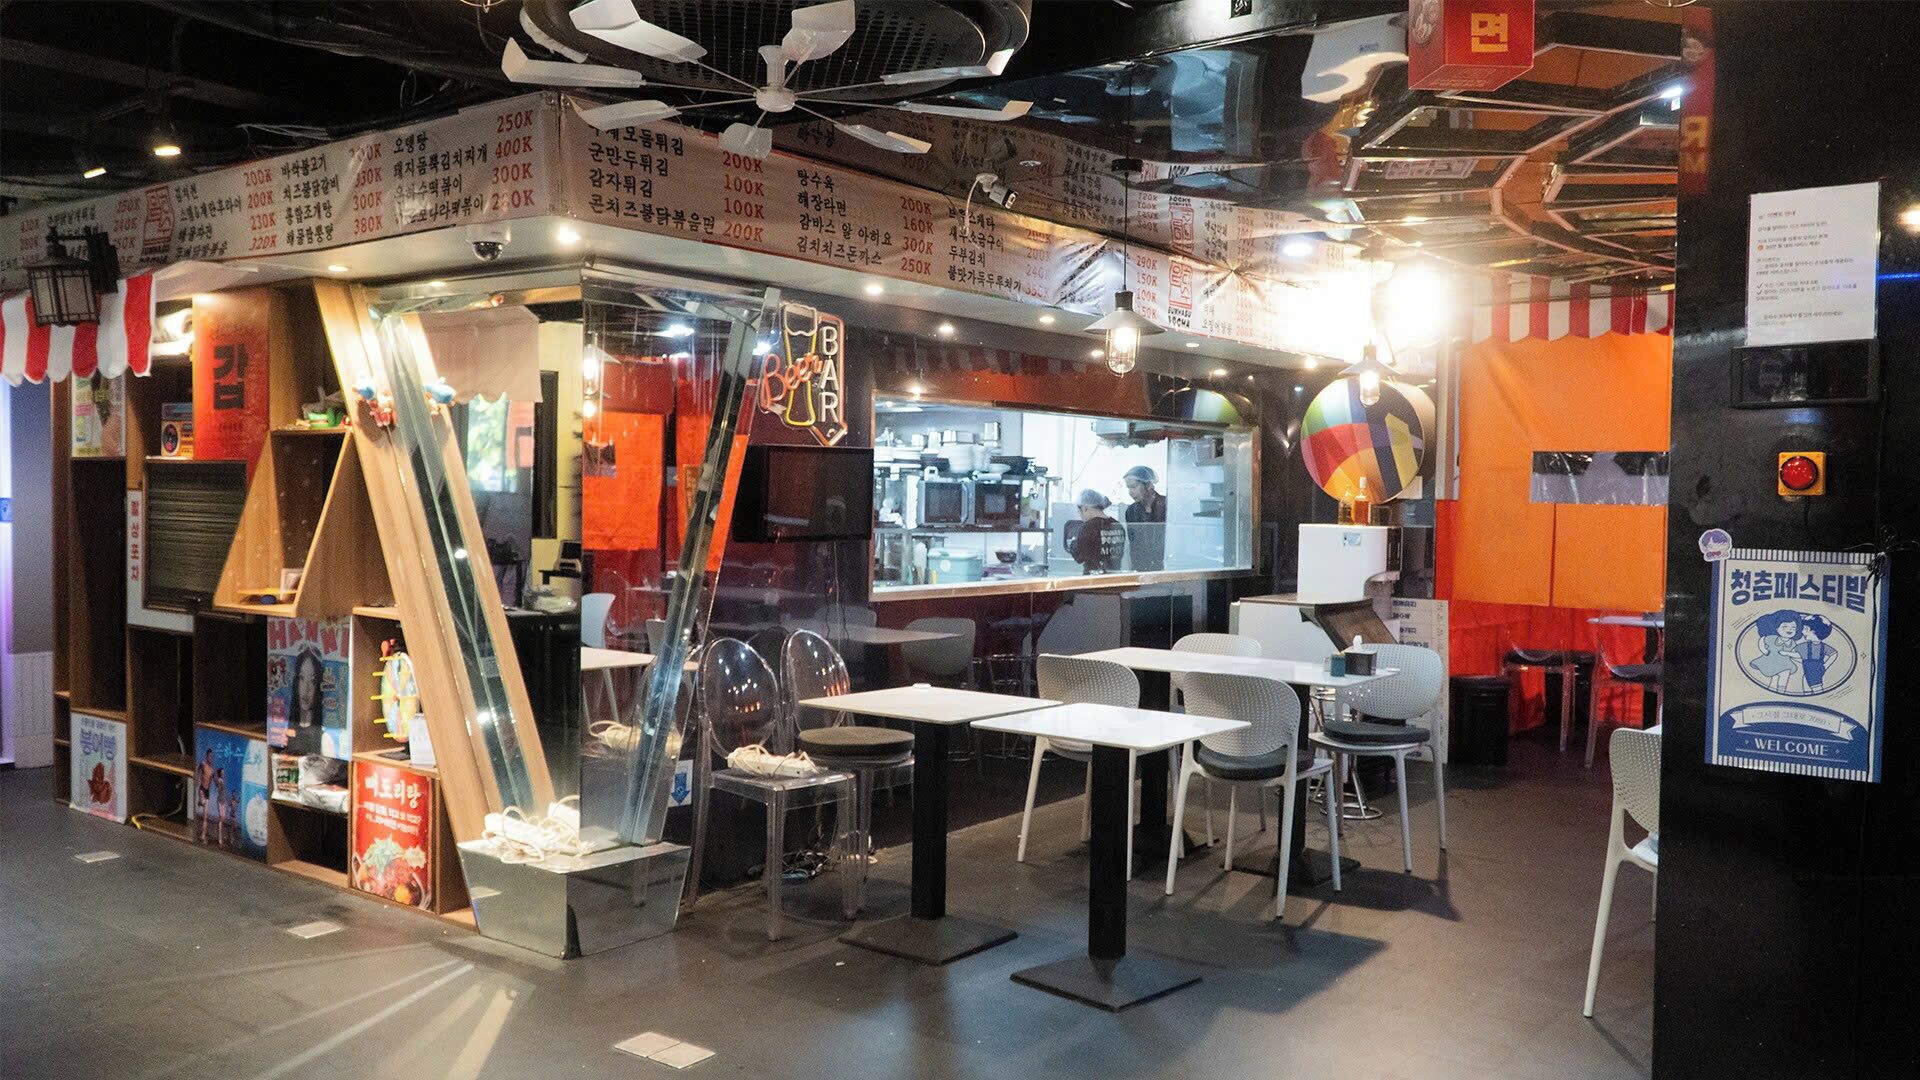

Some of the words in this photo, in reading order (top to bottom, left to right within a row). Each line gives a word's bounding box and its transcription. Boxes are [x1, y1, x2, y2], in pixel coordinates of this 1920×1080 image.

[1471, 13, 1508, 52] 면
[393, 131, 428, 154] 오뎅탕
[496, 109, 533, 133] 250K
[495, 136, 533, 159] 400K
[492, 162, 533, 185] 300K
[589, 142, 669, 177] 군만두튀김
[724, 174, 765, 196] 100K
[723, 151, 764, 174] 200K
[247, 190, 273, 209] 200K
[353, 191, 382, 211] 300K
[589, 168, 653, 198] 감자튀김
[724, 198, 765, 220] 100K
[797, 168, 834, 193] 탕수육
[900, 196, 932, 216] 200K
[250, 212, 276, 231] 230K
[354, 215, 383, 235] 380K
[588, 194, 715, 235] 콘치즈불닭볶음면
[722, 221, 763, 243] 200K
[798, 191, 847, 217] 해장라면
[903, 216, 935, 235] 160K
[800, 213, 836, 234] 감바스
[841, 222, 853, 240] 알
[902, 236, 934, 256] 300K
[796, 236, 882, 265] 김치치즈돈까스
[901, 257, 931, 276] 250K
[949, 245, 986, 268] 두부김치
[1136, 255, 1157, 270] 290K
[947, 264, 1022, 295] 불맛가득두루치기
[760, 352, 823, 410] Beer
[818, 326, 839, 423] BAR
[1730, 568, 1868, 615] 청춘페스티발
[1754, 737, 1829, 757] WELCOME
